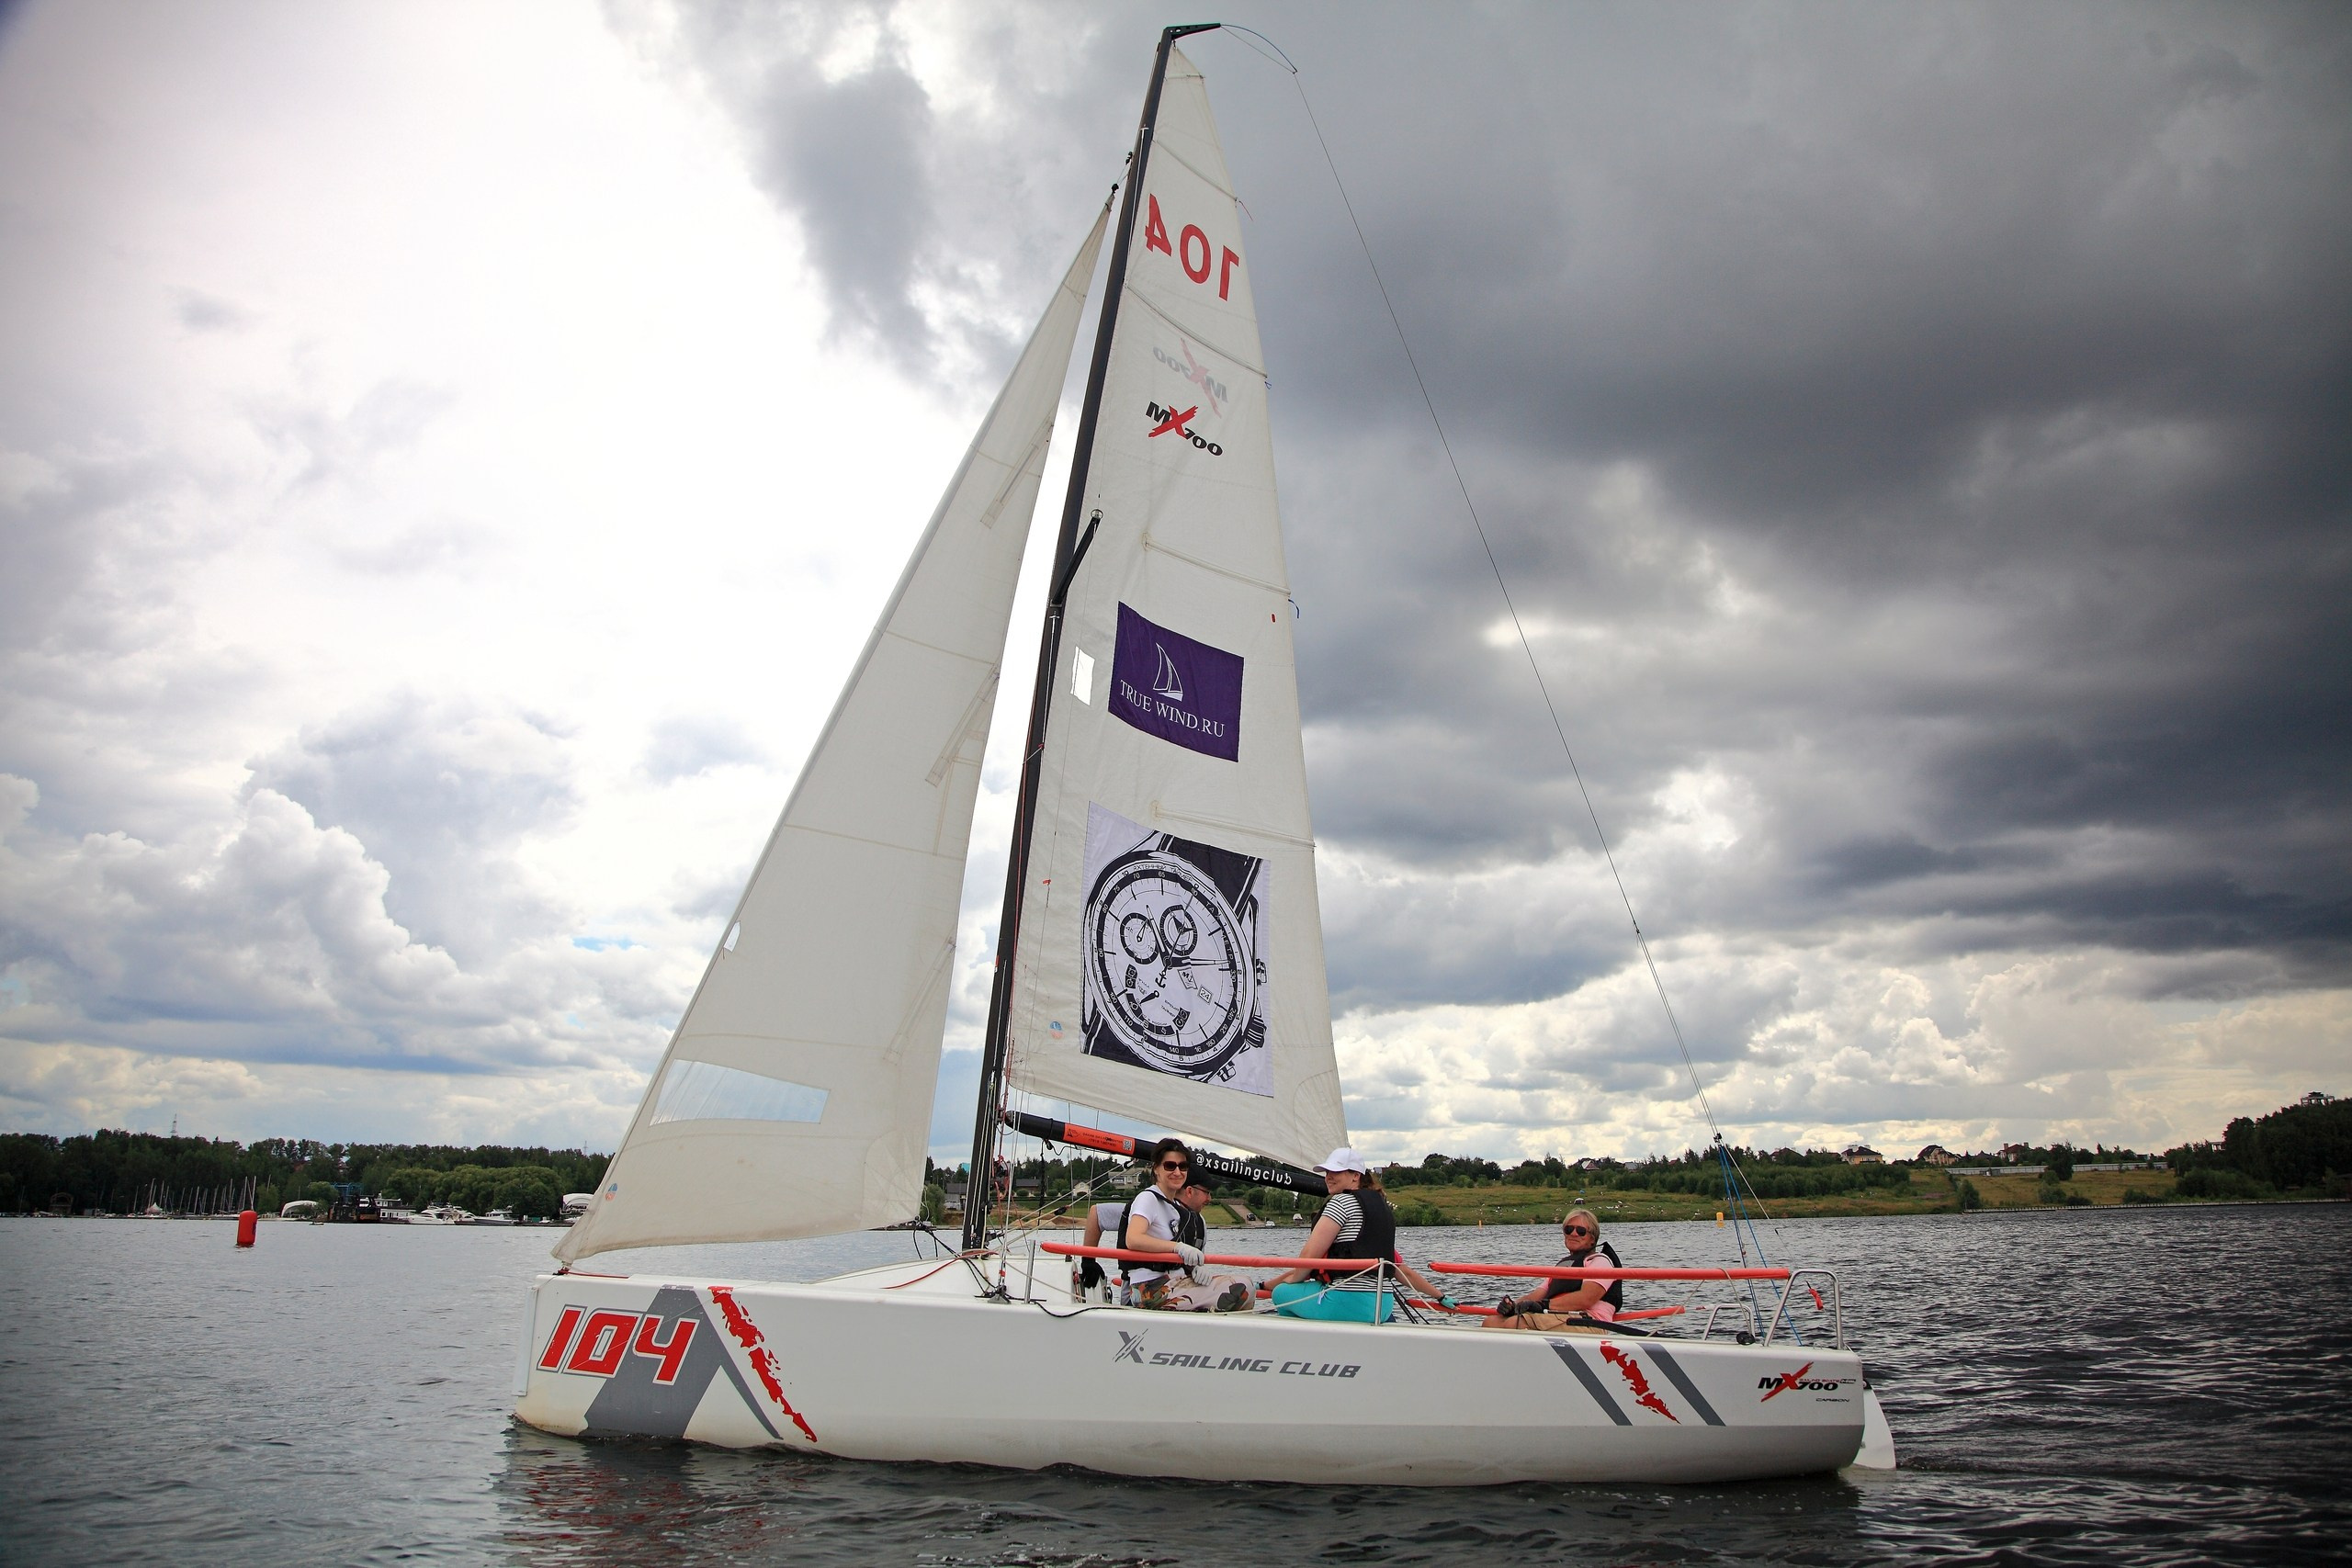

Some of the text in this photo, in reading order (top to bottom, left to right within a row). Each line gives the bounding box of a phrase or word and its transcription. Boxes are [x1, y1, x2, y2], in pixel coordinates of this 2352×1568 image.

[1120, 679, 1226, 738] TRUE WIND.RU
[1195, 1153, 1293, 1186] @xsailingclub
[536, 1303, 701, 1386] 104
[1148, 1352, 1274, 1373] SAILING
[1278, 1360, 1363, 1379] CLUB
